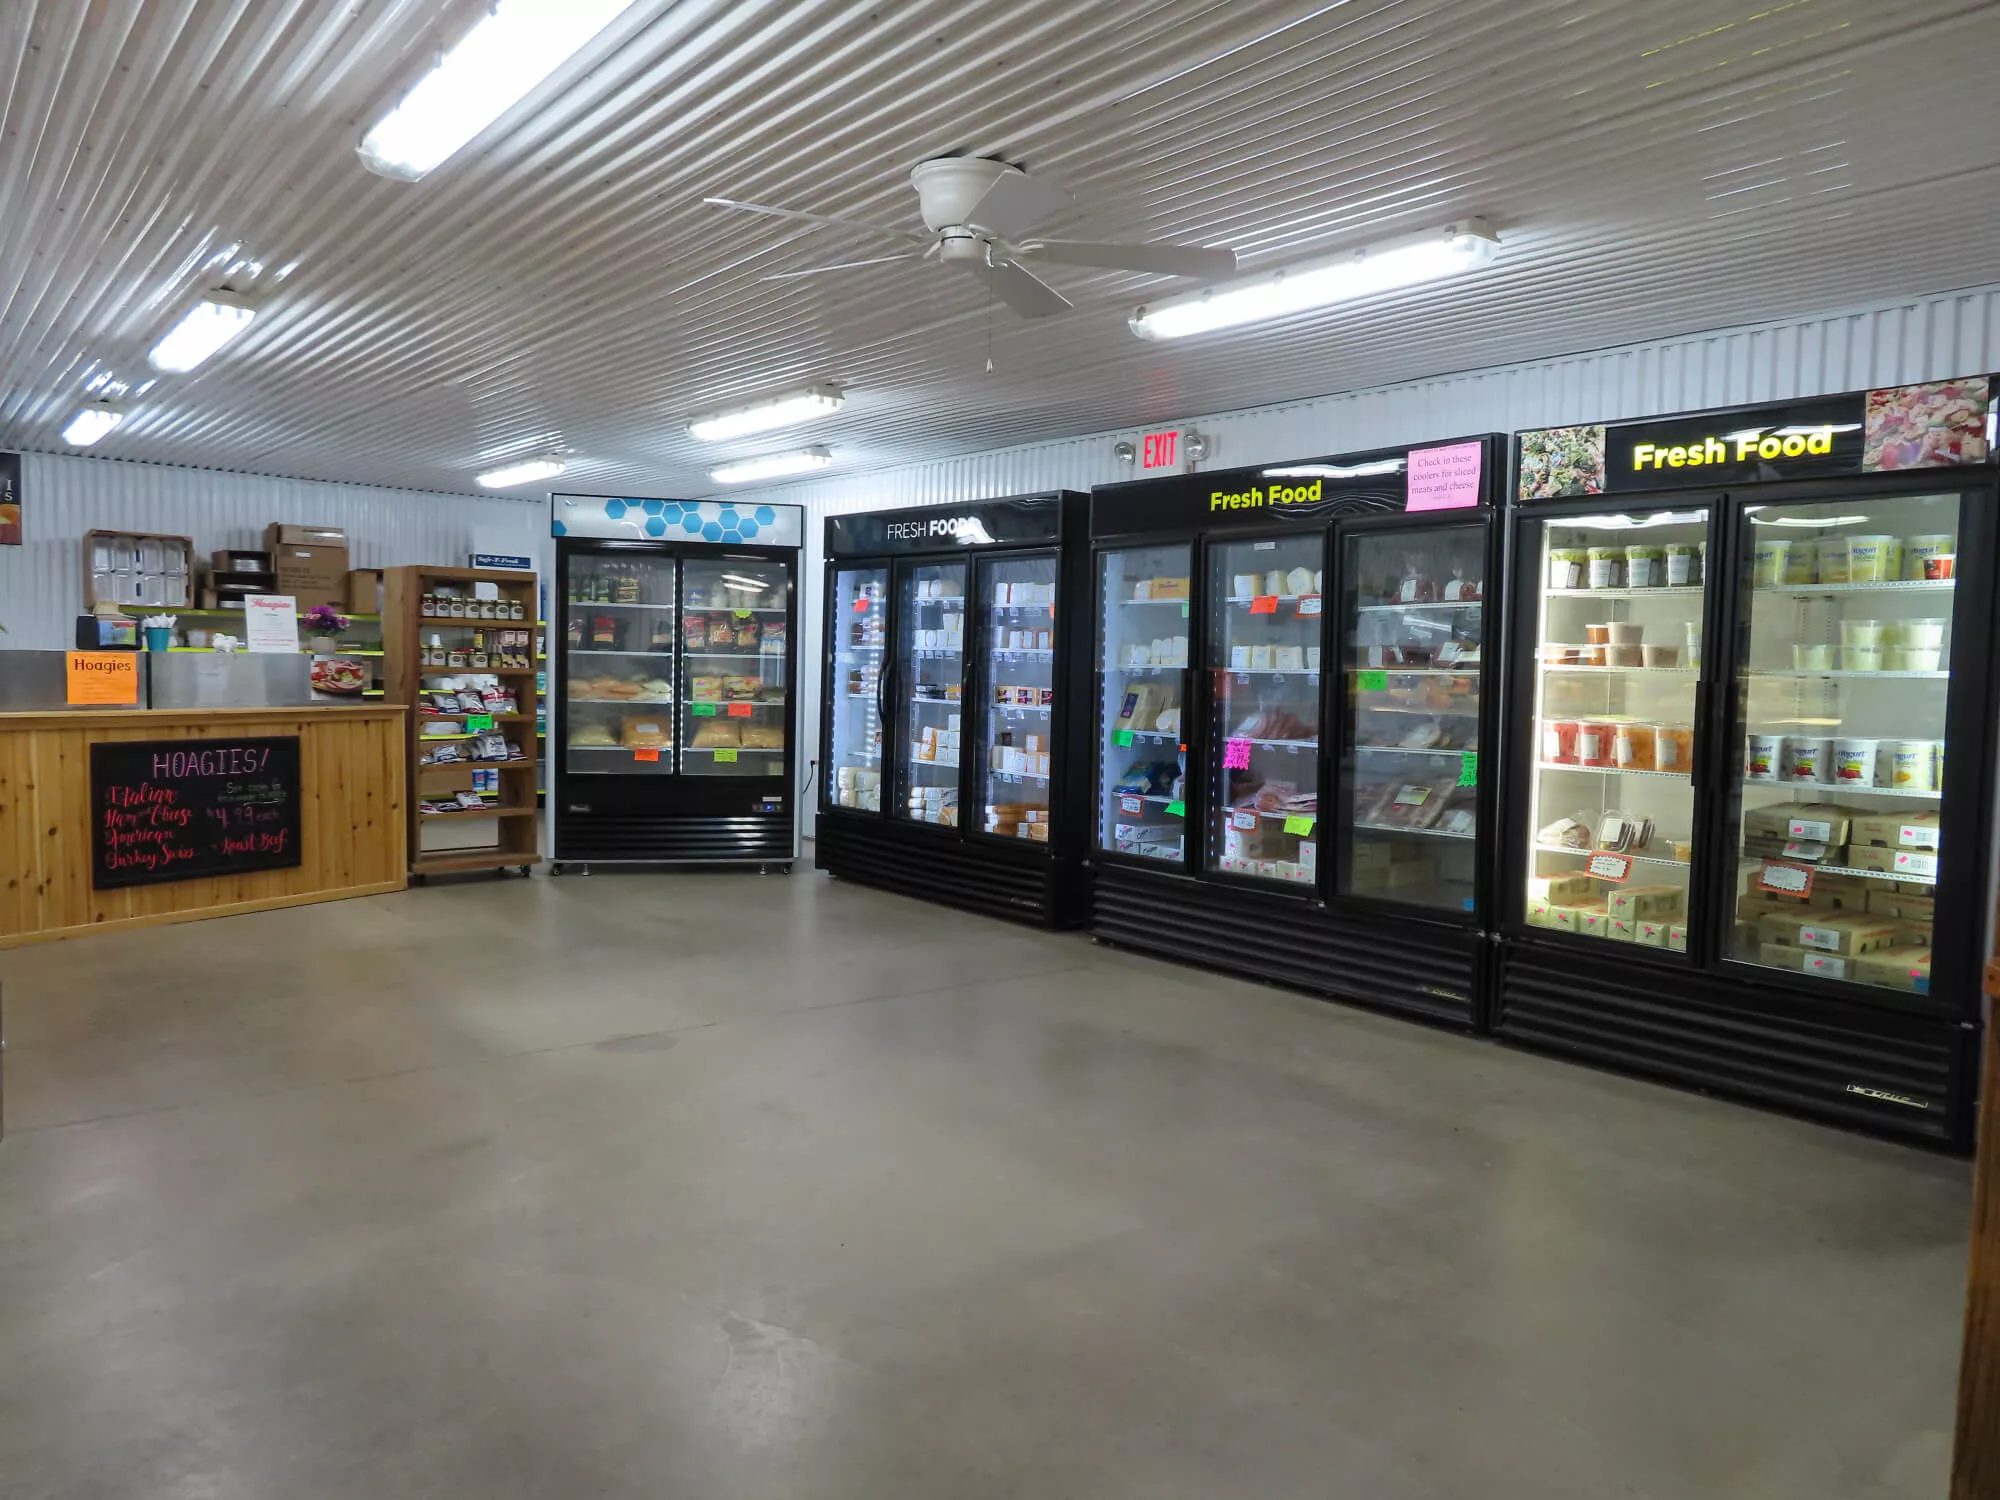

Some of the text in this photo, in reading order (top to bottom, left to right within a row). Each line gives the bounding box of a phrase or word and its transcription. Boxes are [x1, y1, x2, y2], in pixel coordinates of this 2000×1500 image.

[1143, 431, 1178, 468] EXIT
[1633, 425, 1833, 471] Fresh Food
[1417, 454, 1472, 468] Check in these
[1413, 466, 1477, 481] coolers for sliced
[1210, 480, 1322, 511] Fresh Food
[1411, 481, 1474, 494] meats and cheese
[887, 521, 927, 540] FRESH
[74, 658, 131, 674] Hoagies
[153, 748, 269, 778] HOAGIES!
